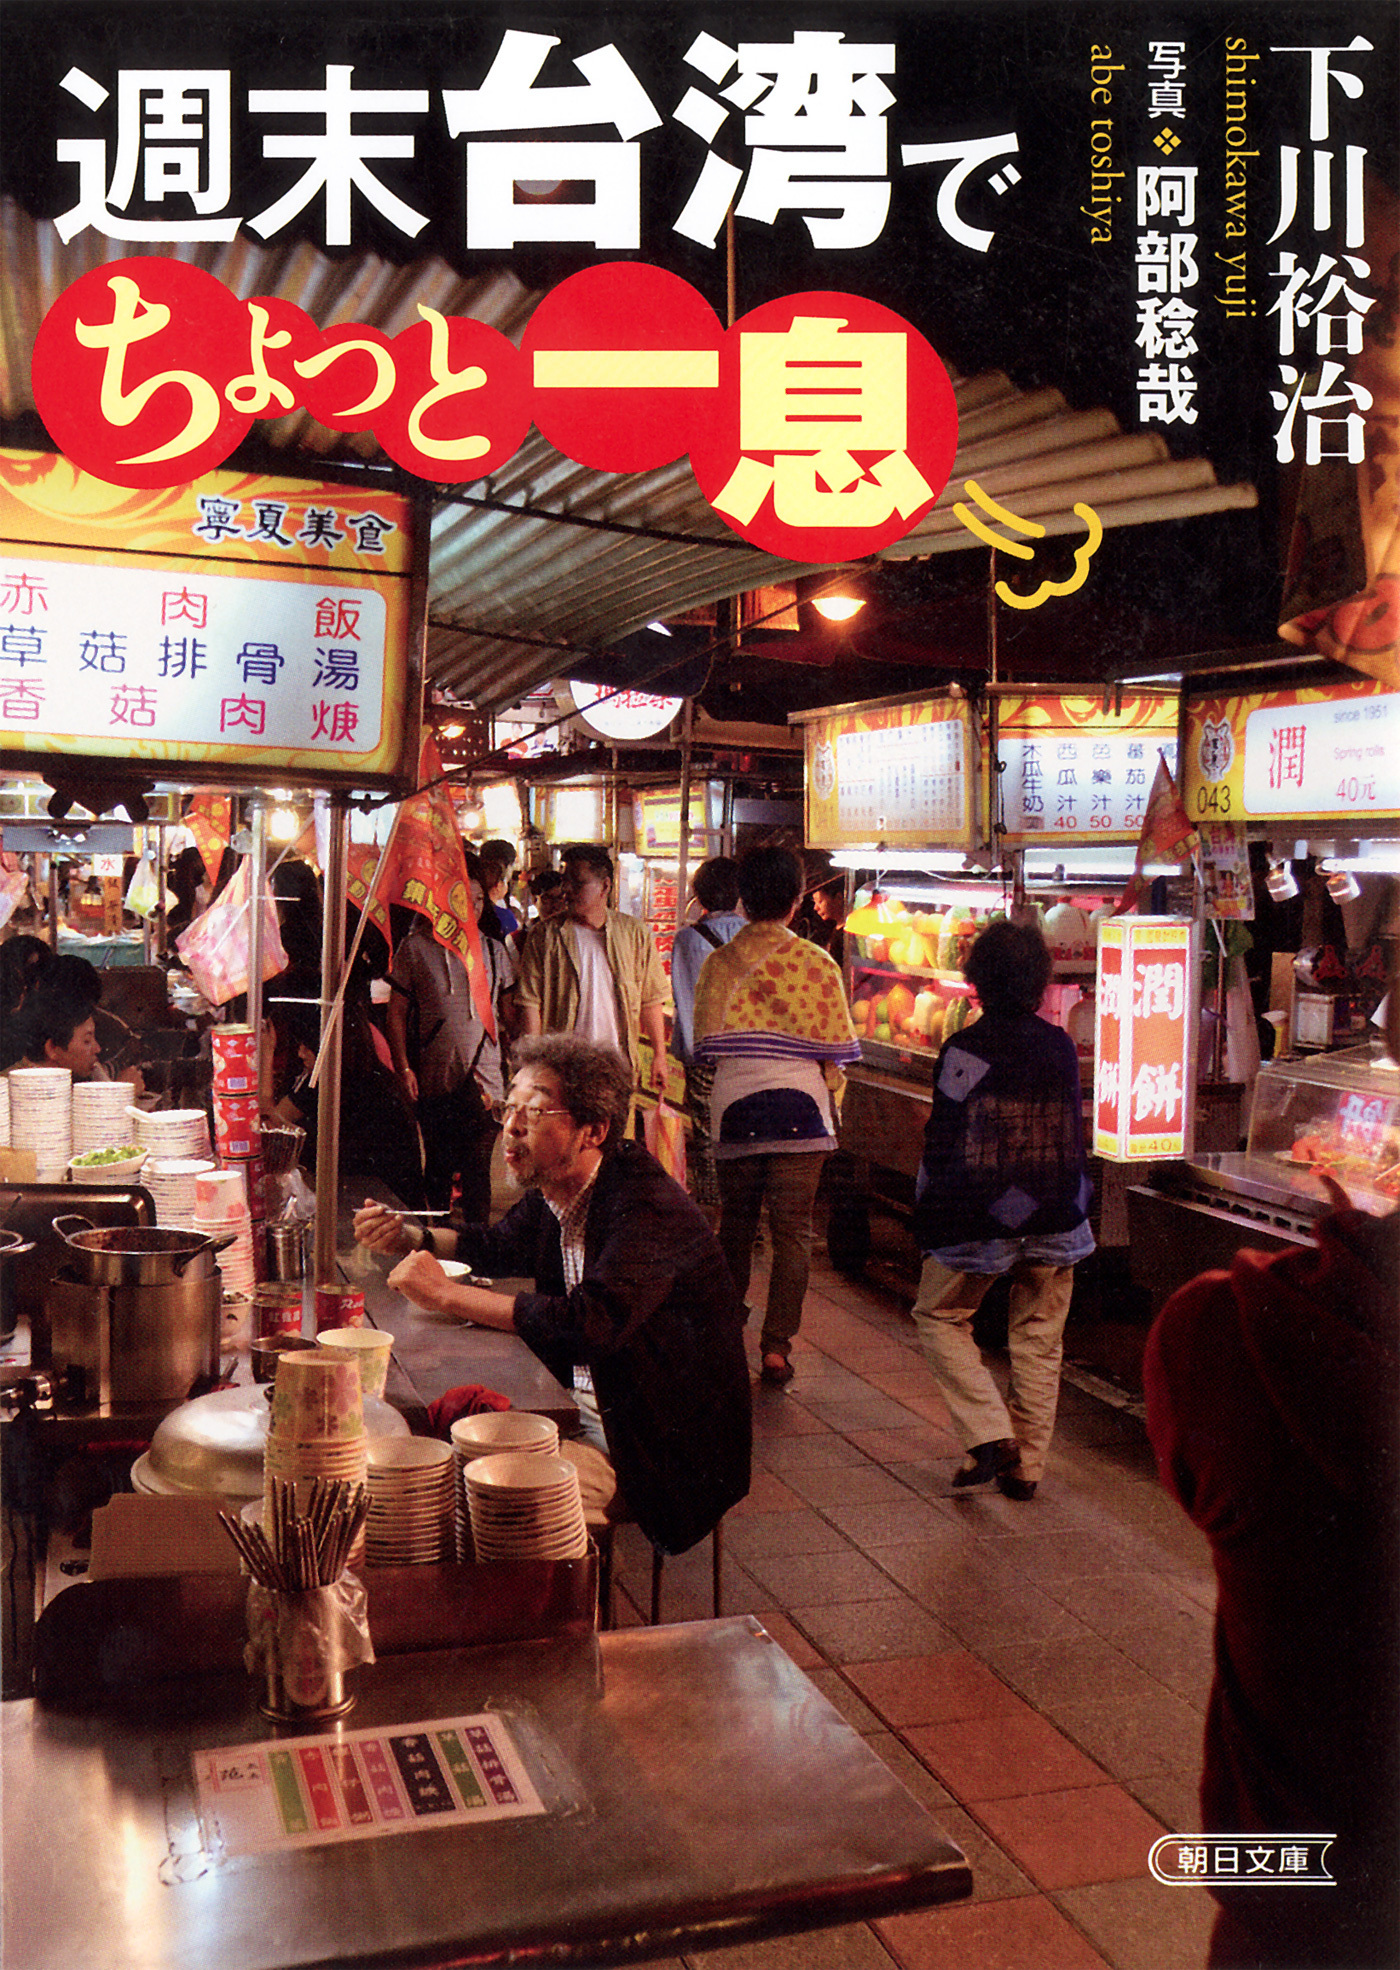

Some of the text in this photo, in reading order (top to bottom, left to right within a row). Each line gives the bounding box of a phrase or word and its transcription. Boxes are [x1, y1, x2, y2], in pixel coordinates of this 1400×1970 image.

[196, 497, 395, 553] 寧夏美食
[1022, 744, 1044, 813] 木瓜牛奶
[1269, 724, 1307, 789] 潤
[1054, 815, 1077, 828] 40
[1089, 815, 1112, 828] 50
[1124, 814, 1145, 828] 50
[1197, 785, 1232, 814] 043
